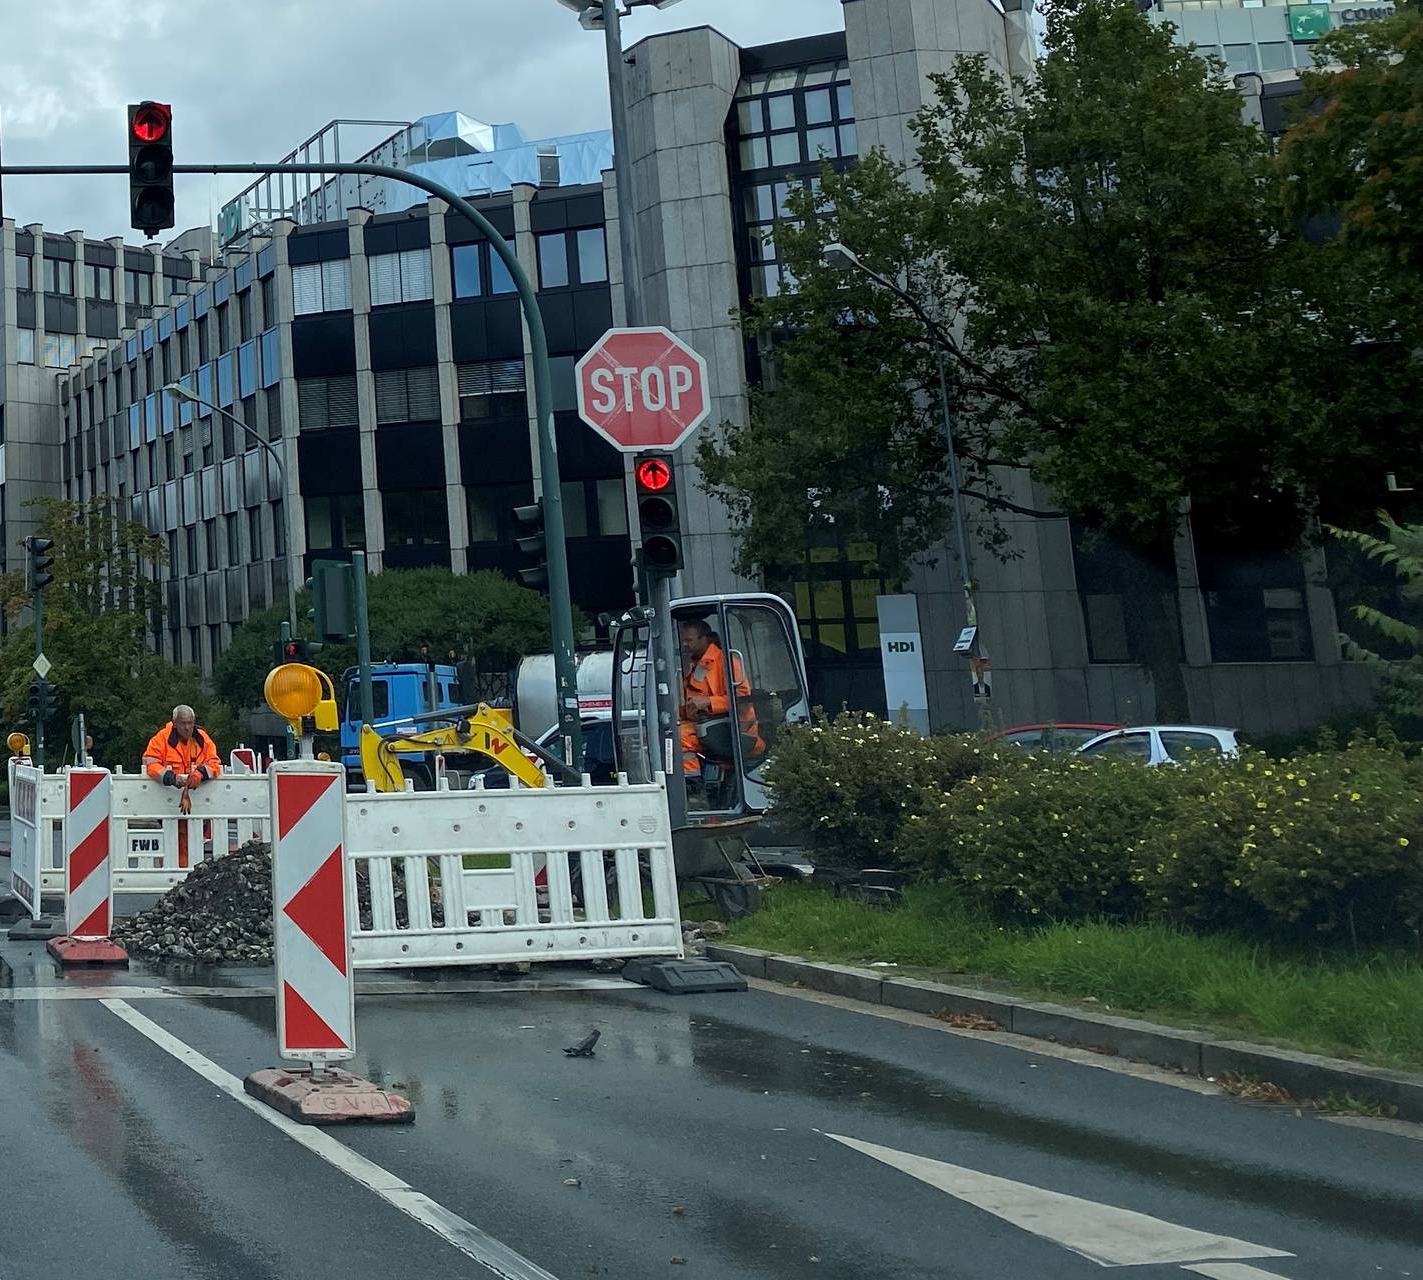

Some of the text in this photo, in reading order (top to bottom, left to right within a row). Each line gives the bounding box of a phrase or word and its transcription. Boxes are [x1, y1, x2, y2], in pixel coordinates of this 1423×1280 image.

[590, 364, 693, 414] STOP
[888, 641, 915, 652] HDI
[132, 839, 160, 851] FWB
